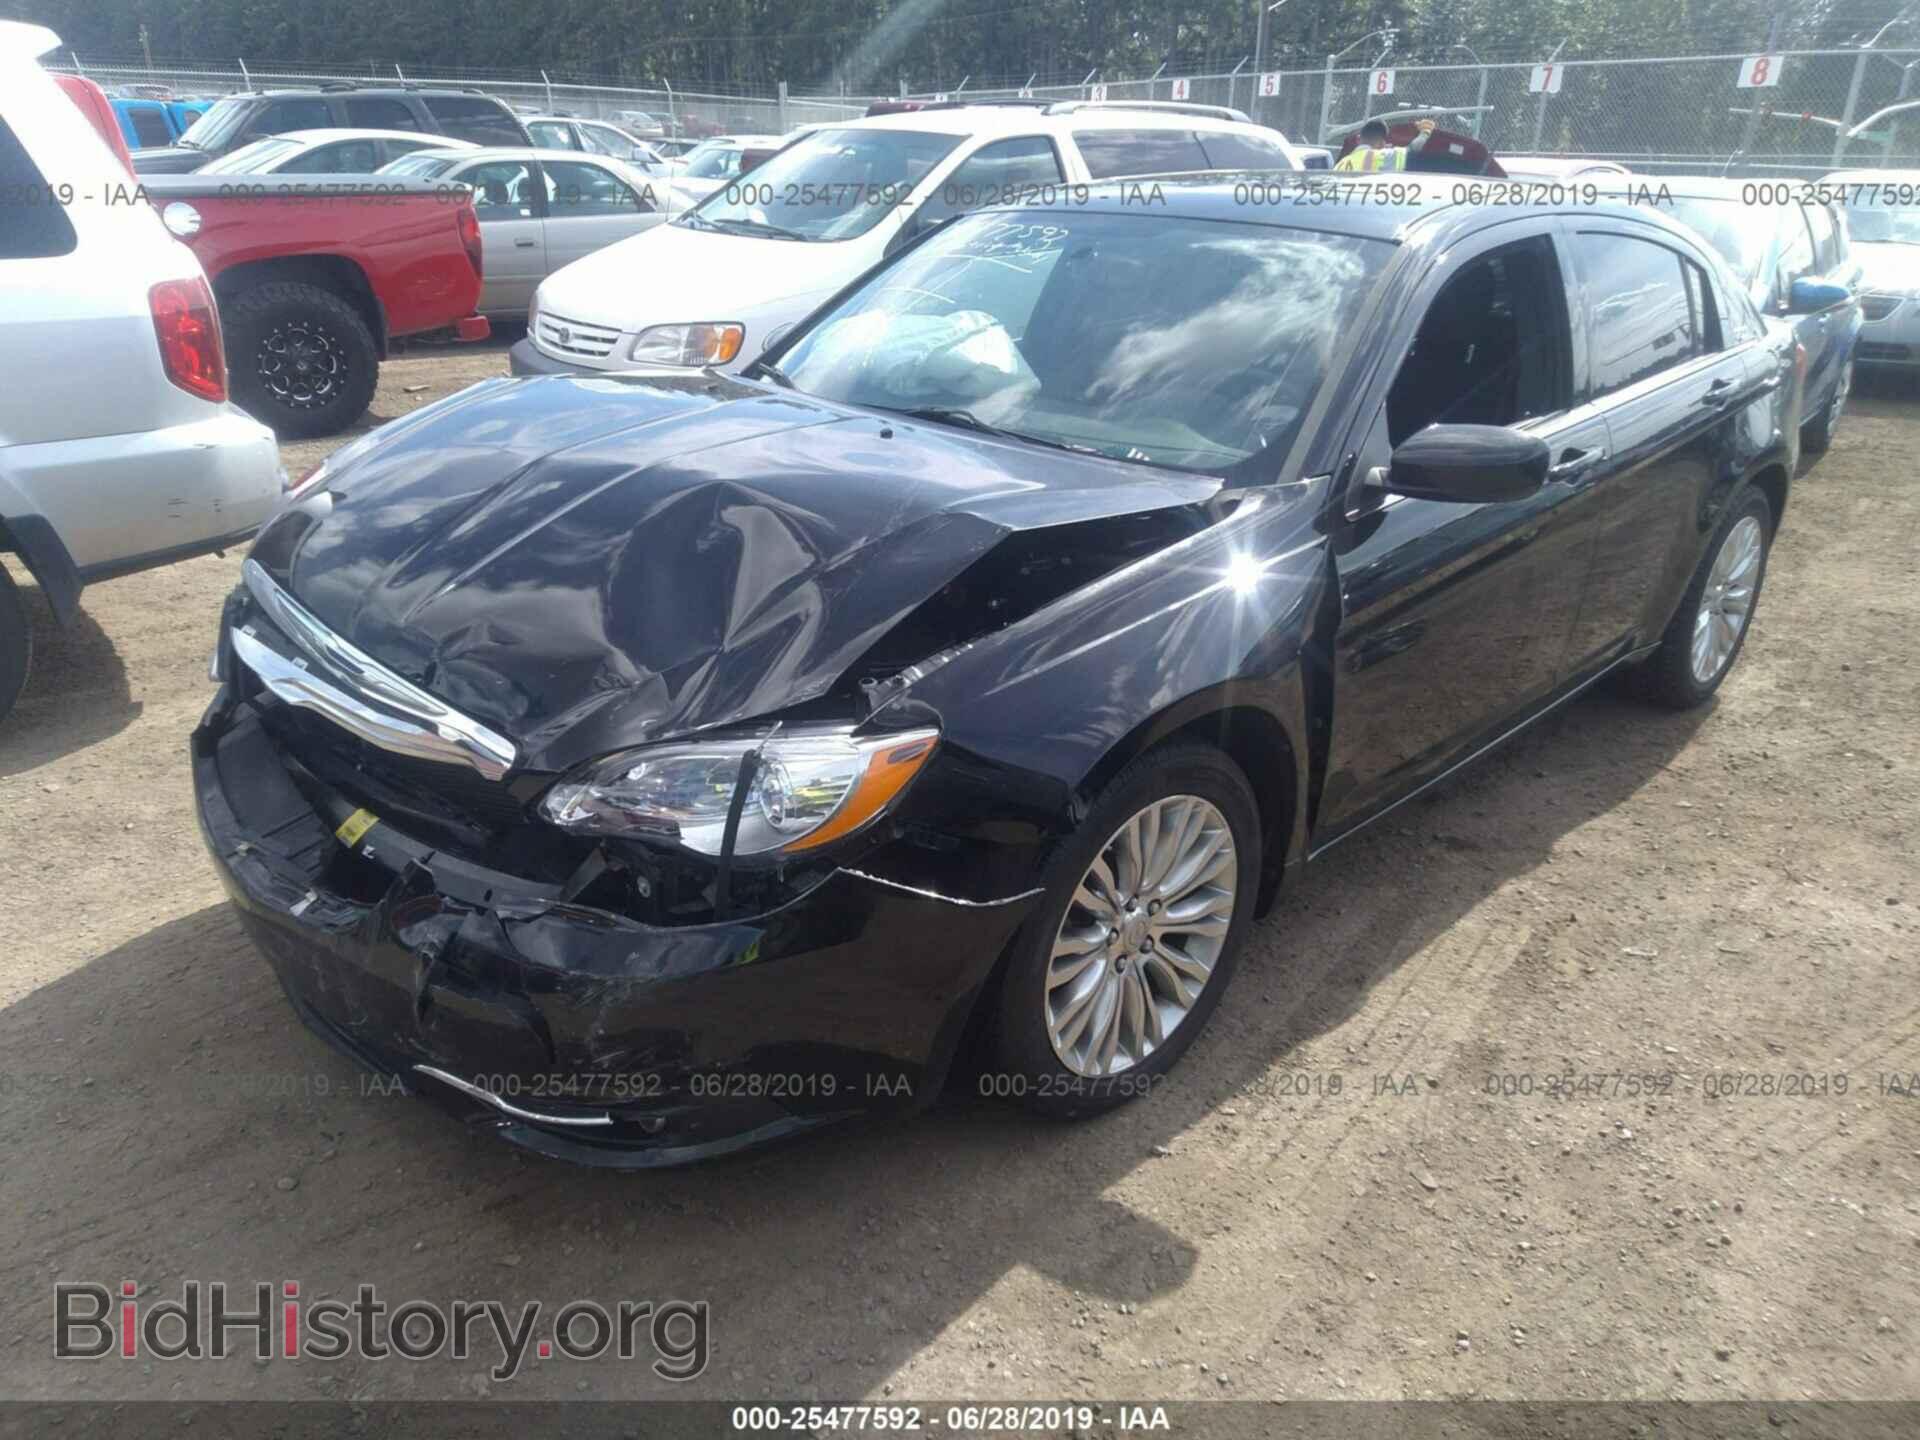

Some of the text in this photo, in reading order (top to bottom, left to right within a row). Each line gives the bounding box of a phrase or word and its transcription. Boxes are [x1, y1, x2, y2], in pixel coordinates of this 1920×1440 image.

[1542, 65, 1555, 91] 7
[1750, 57, 1770, 85] 8
[1174, 80, 1186, 97] 4
[1264, 75, 1275, 96] 5
[1376, 72, 1388, 94] 6
